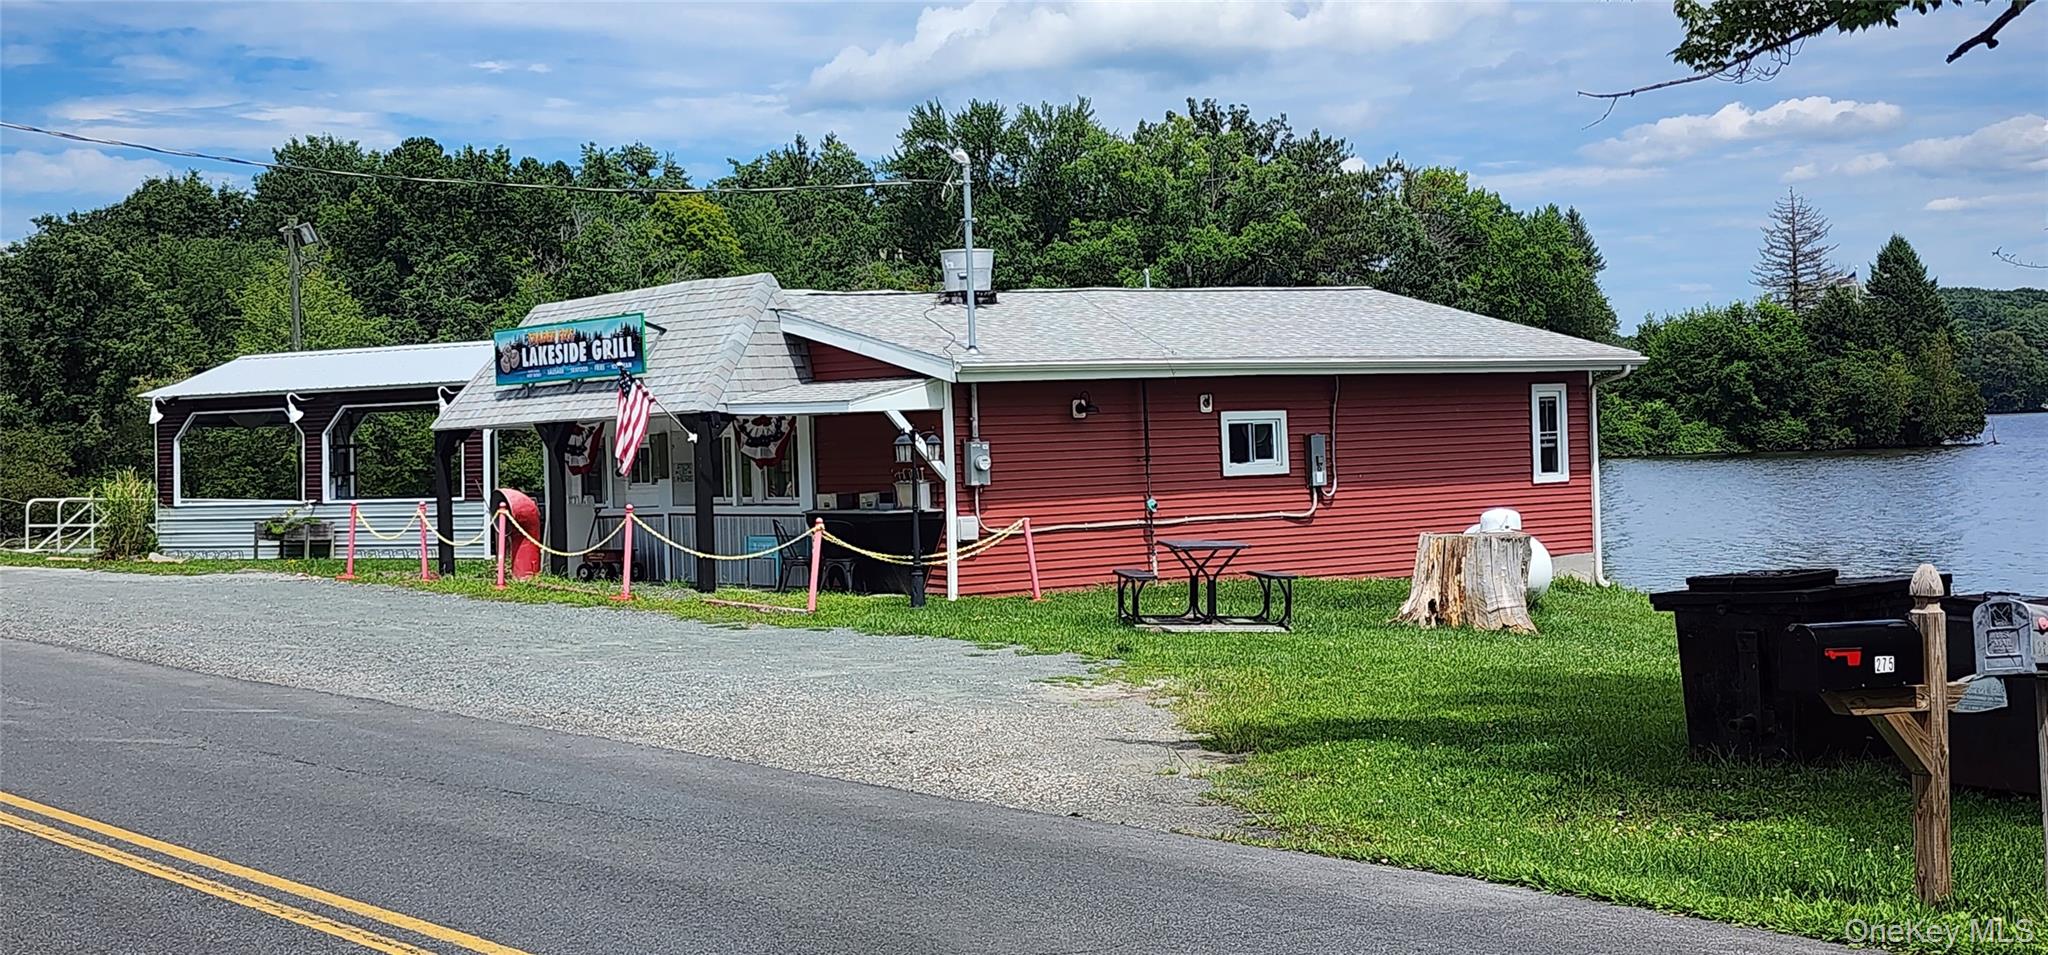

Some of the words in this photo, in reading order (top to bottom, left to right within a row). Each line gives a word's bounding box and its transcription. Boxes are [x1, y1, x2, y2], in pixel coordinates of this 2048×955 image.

[521, 341, 587, 367] LAKESIDE
[592, 336, 636, 360] GRILL
[1876, 657, 1894, 672] 275
